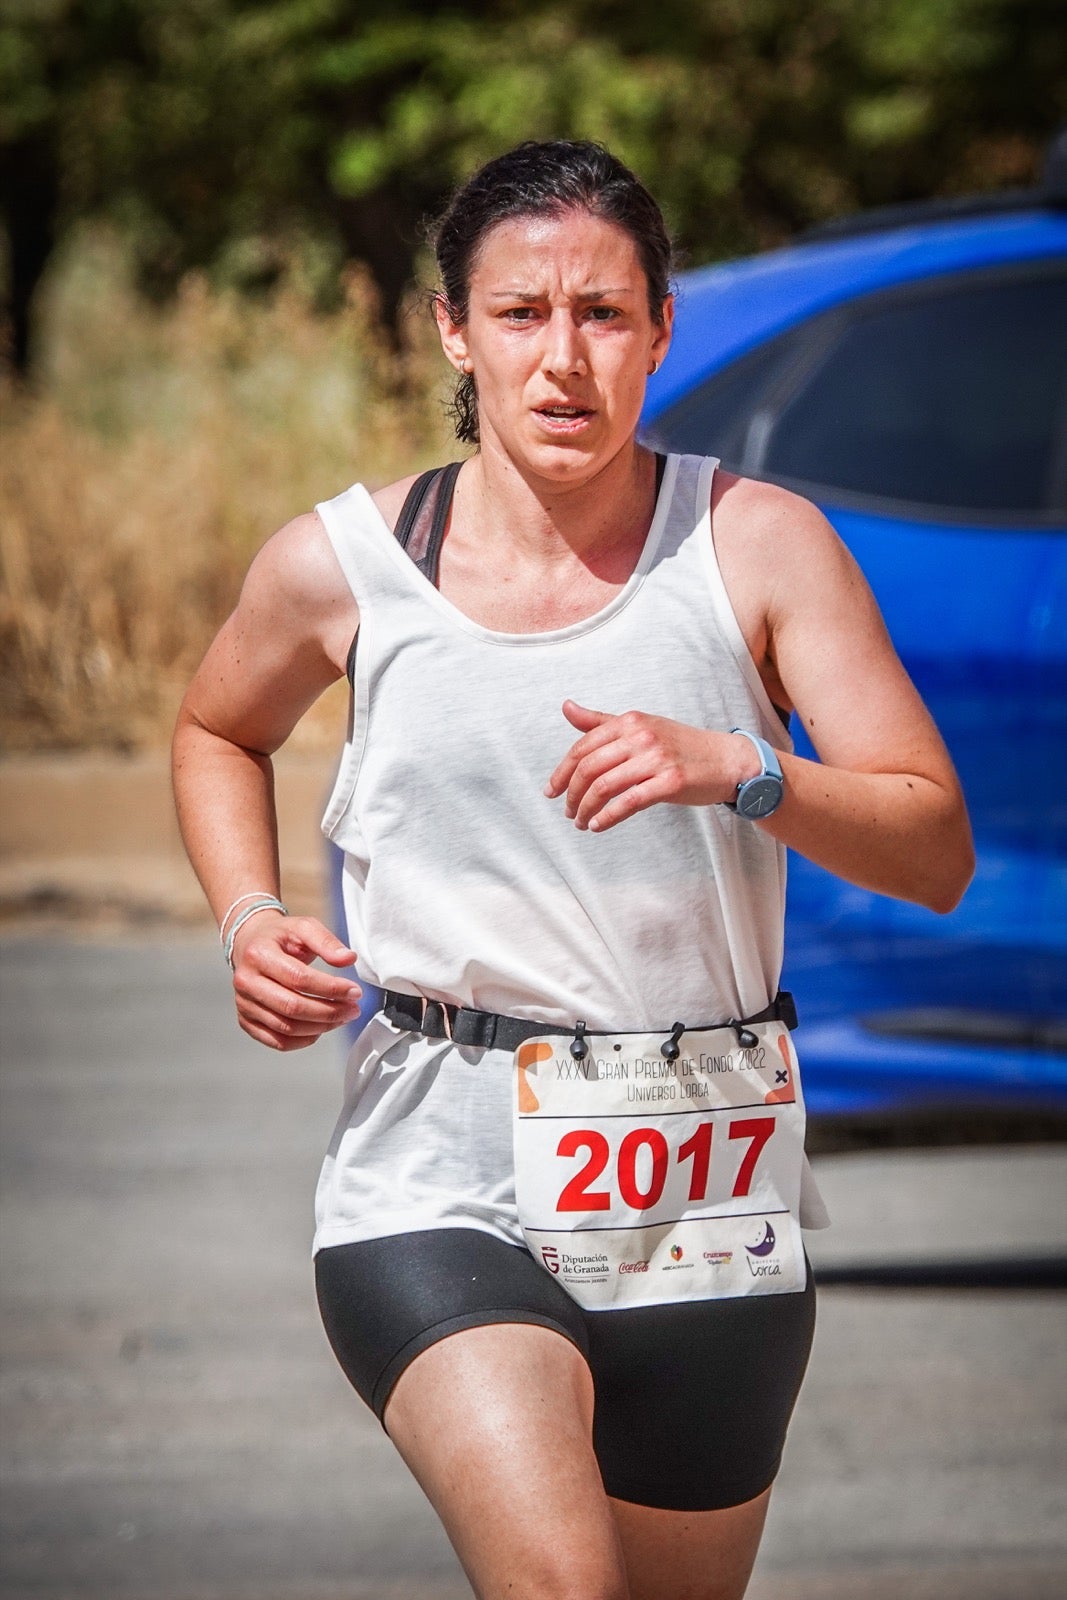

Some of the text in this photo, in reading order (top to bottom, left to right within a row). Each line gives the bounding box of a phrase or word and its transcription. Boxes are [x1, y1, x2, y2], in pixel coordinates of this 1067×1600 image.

[556, 1060, 591, 1081] XXXV
[738, 1047, 767, 1071] 2022
[556, 1117, 776, 1213] 2017
[562, 1254, 608, 1265] Diputación
[563, 1264, 610, 1274] de Granada
